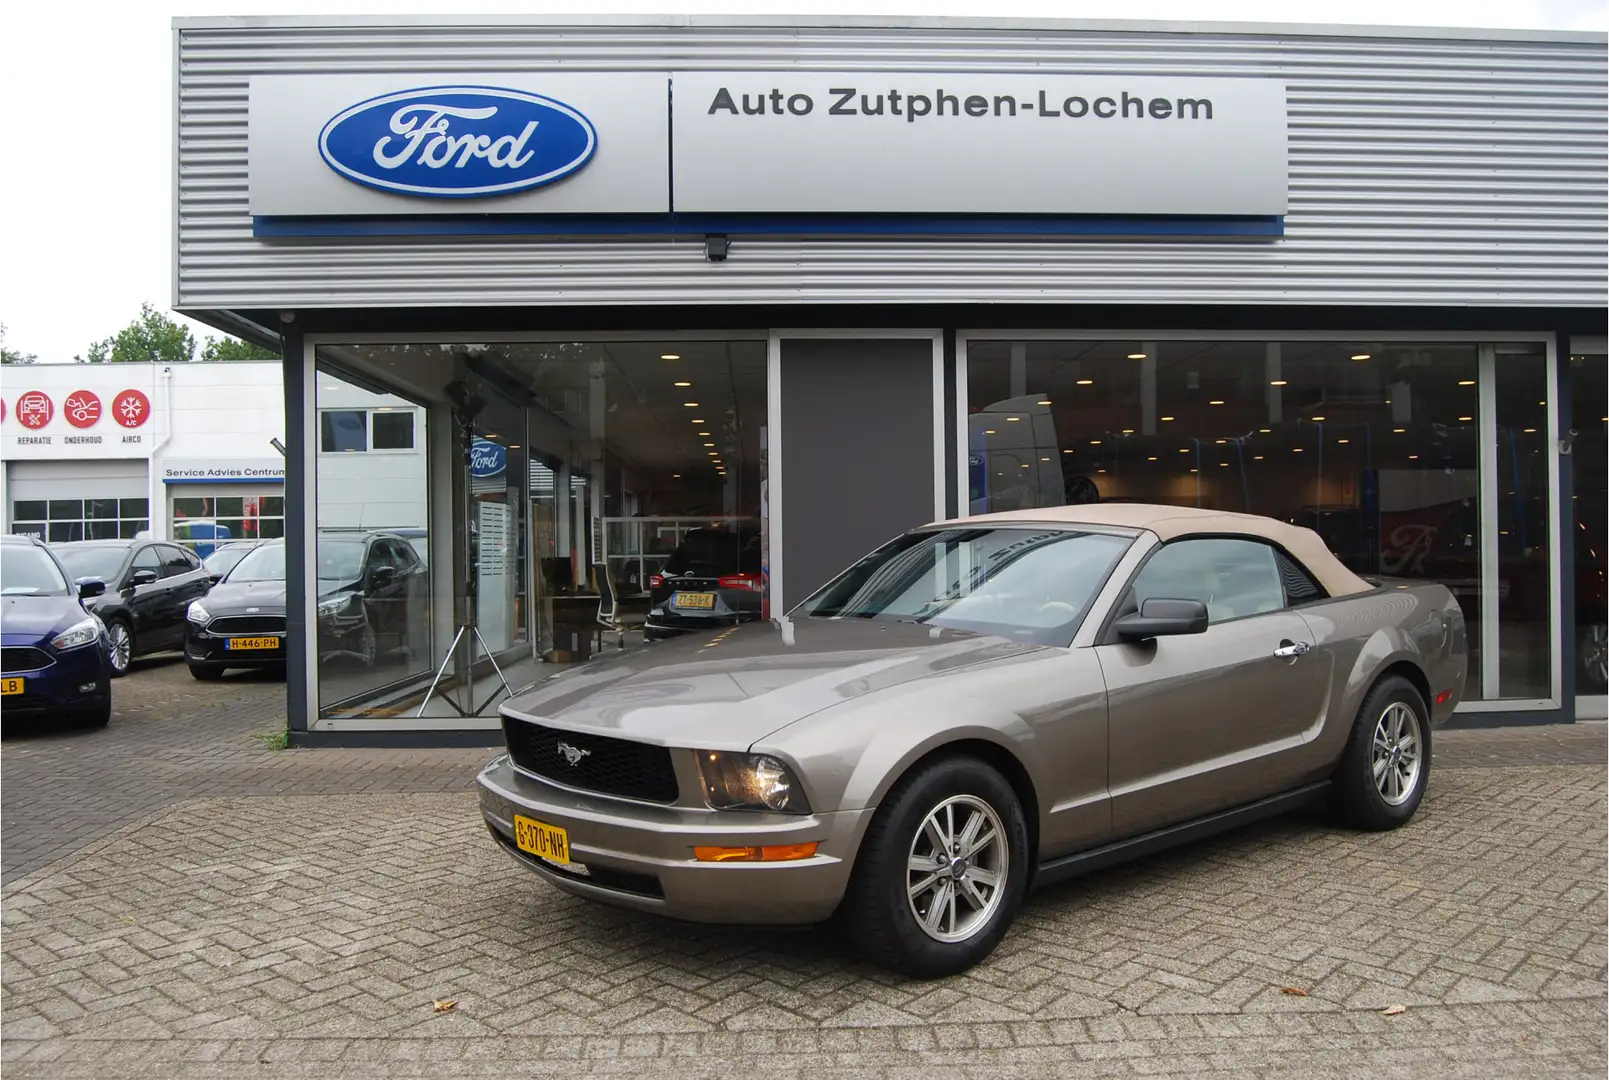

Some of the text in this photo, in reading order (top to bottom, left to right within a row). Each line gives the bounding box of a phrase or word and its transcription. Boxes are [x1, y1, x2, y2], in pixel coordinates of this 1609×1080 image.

[707, 87, 1213, 123] Auto Zutphen-Lochem
[373, 104, 539, 169] Ford
[17, 436, 52, 445] REPARATIE
[64, 436, 102, 445] ONDERHOUD
[121, 435, 142, 443] AIRCO
[166, 469, 205, 477] Service
[518, 820, 565, 859] G-370-NH
